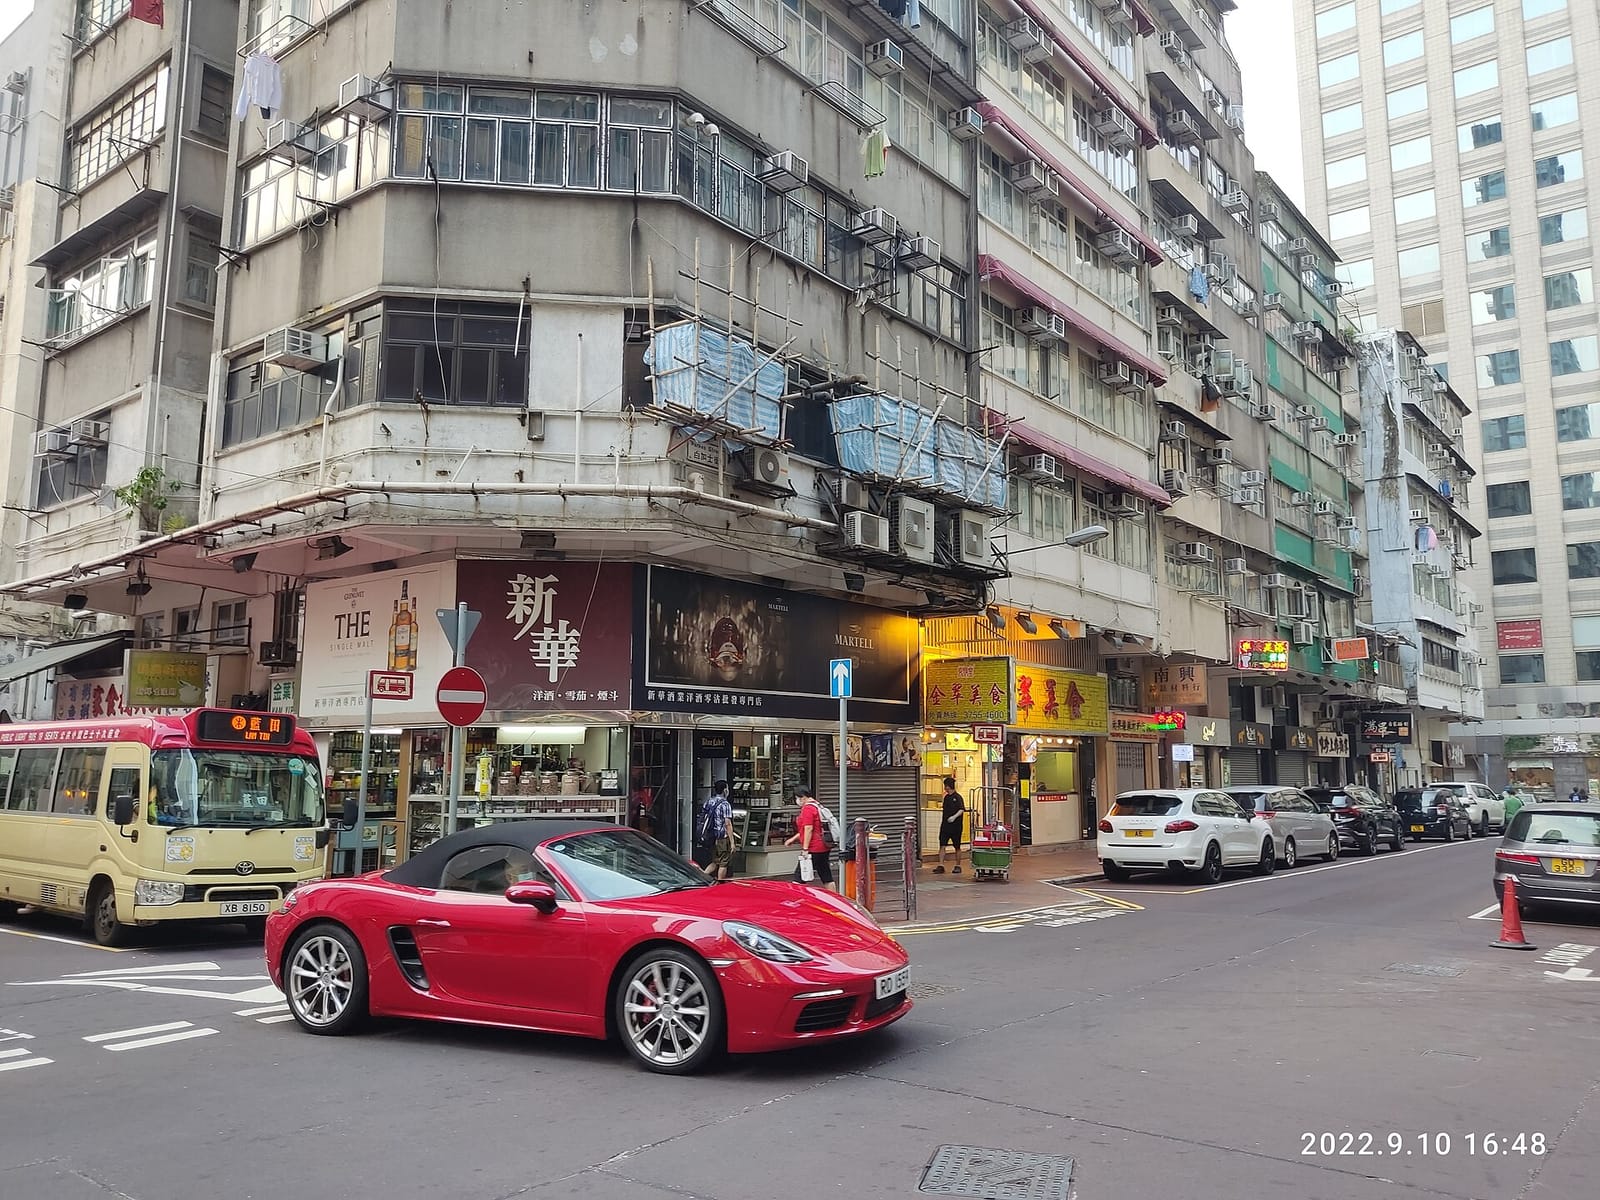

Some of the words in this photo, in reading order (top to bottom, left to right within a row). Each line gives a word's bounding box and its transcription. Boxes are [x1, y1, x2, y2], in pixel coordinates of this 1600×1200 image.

[768, 603, 789, 612] MARTELL
[334, 610, 372, 640] THE
[834, 633, 875, 649] MARTELL
[224, 904, 238, 913] XB
[242, 903, 266, 913] 8150
